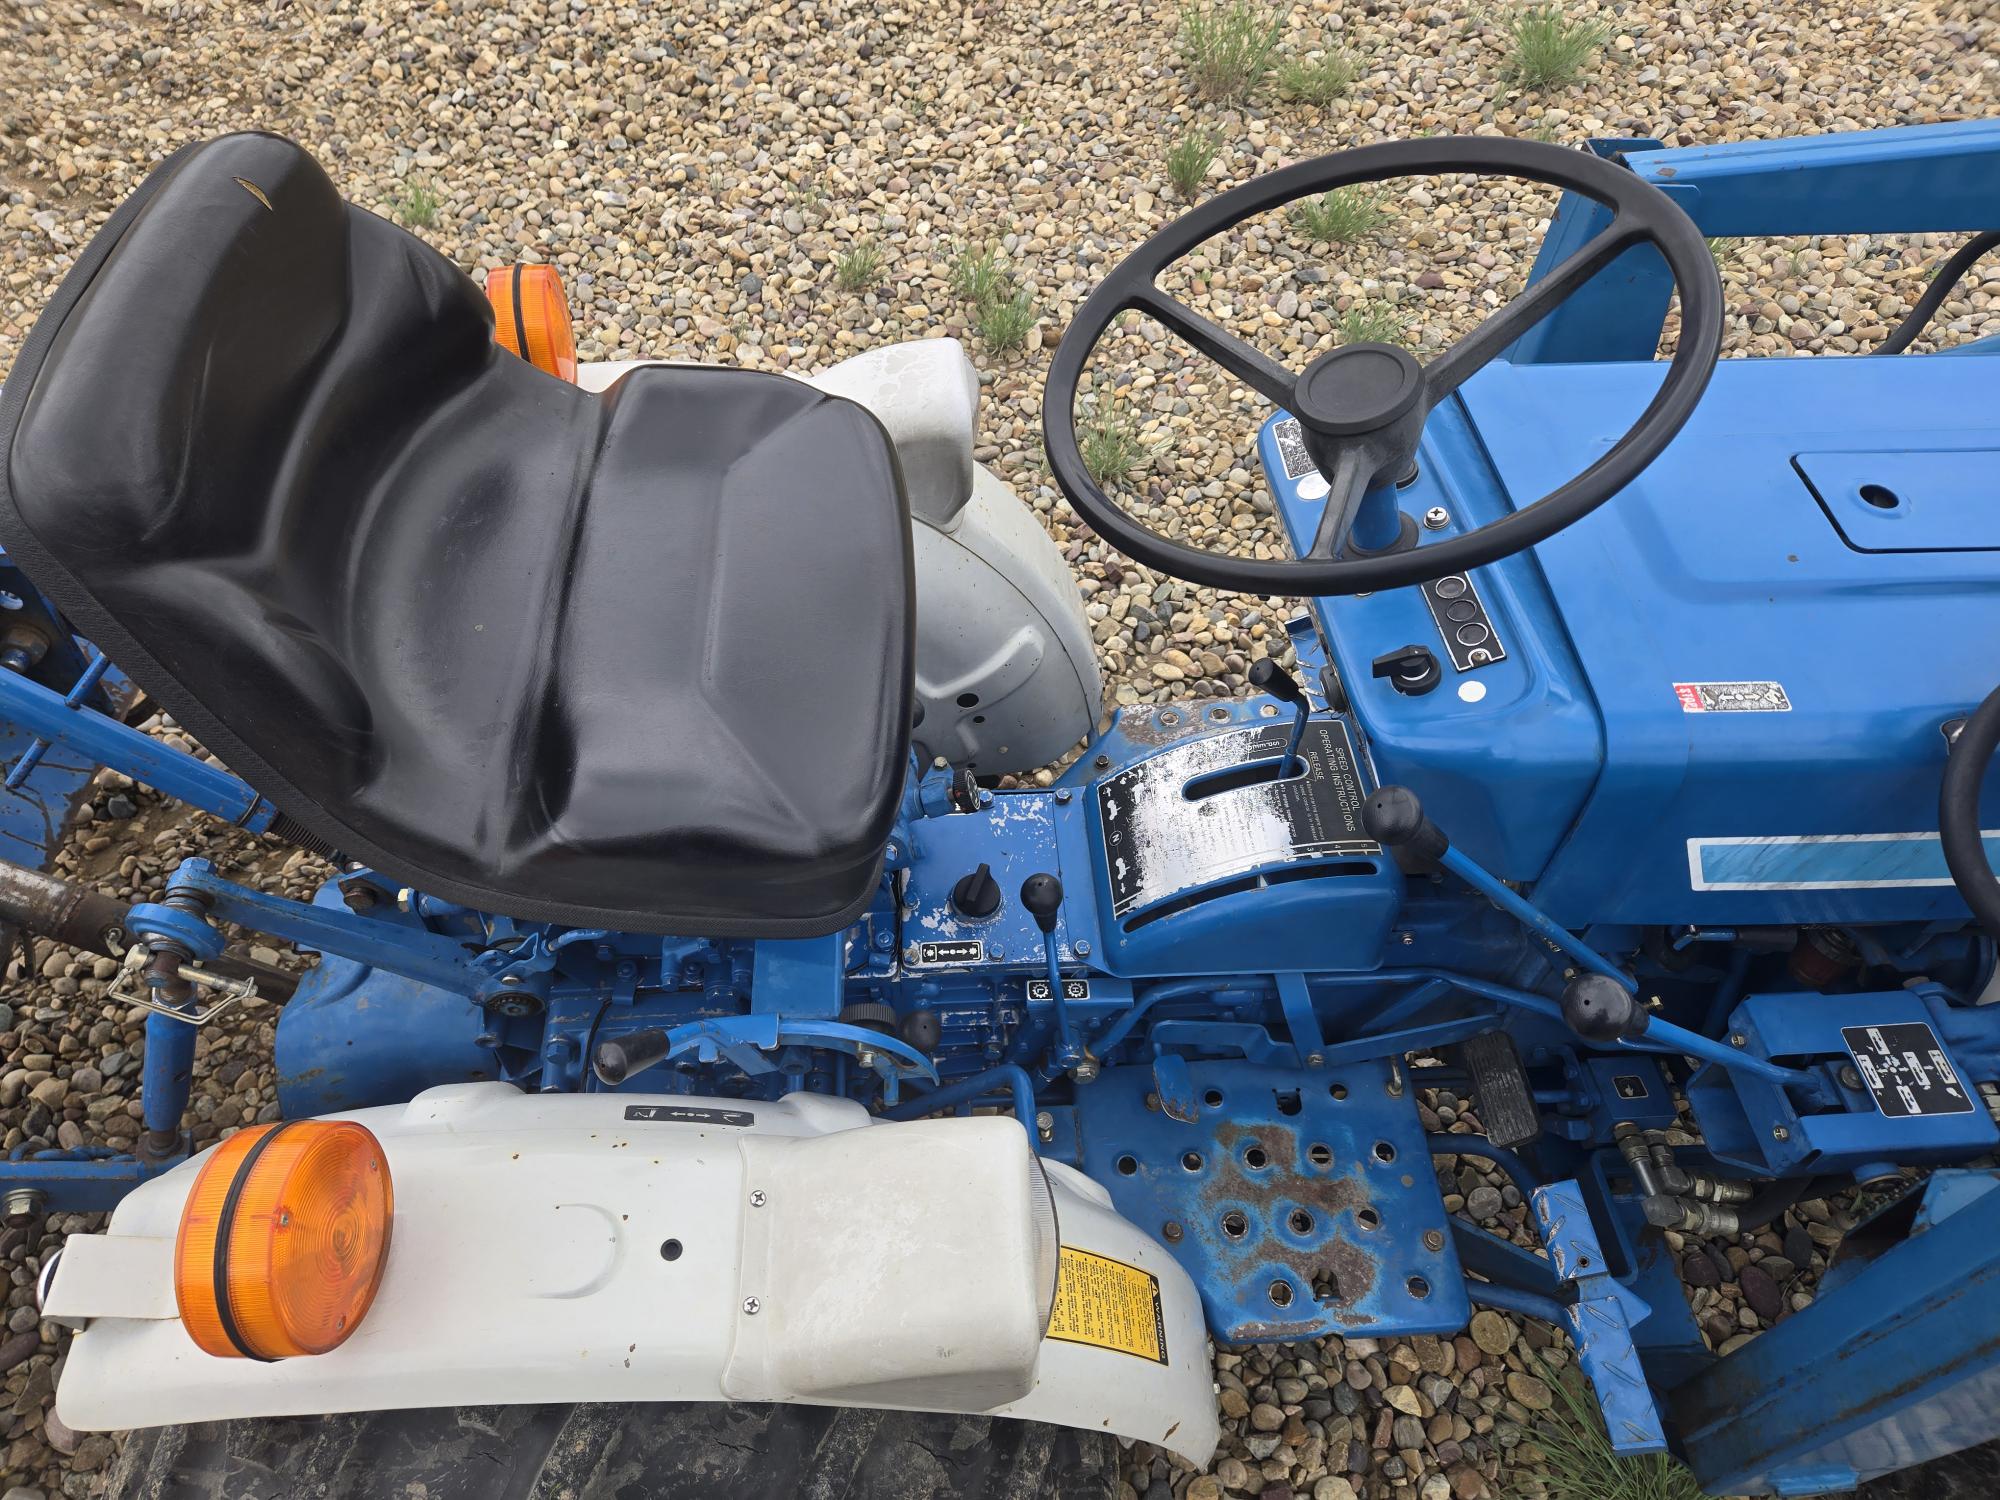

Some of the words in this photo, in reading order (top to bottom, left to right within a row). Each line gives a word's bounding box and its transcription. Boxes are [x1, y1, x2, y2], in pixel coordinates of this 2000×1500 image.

[1677, 688, 1698, 710] STOP
[1309, 751, 1324, 780] RELEASE
[1319, 729, 1338, 771] OPERATING
[1332, 773, 1356, 832] INSTRUCTIONS
[1335, 747, 1349, 771] SPEED
[1343, 773, 1361, 811] CONTROL
[1154, 1301, 1166, 1359] WARNING
